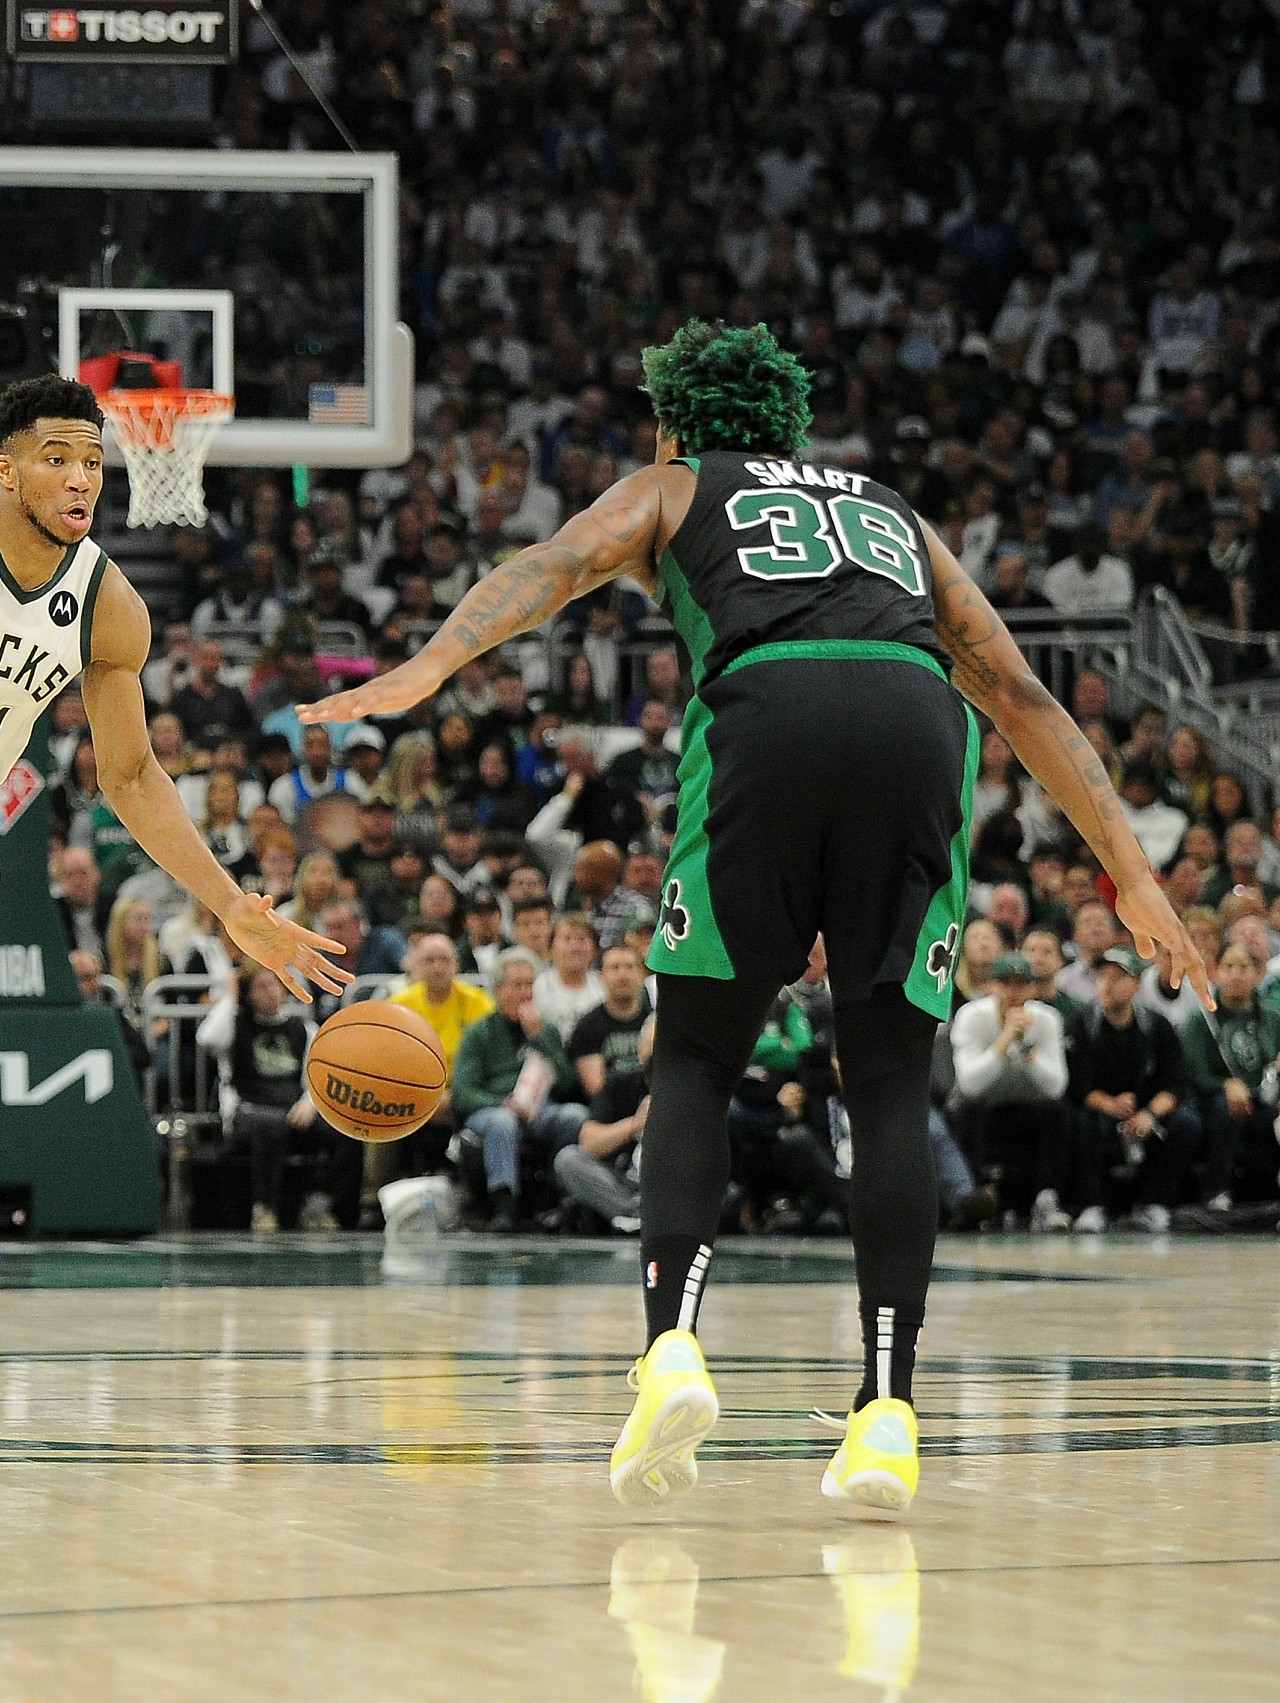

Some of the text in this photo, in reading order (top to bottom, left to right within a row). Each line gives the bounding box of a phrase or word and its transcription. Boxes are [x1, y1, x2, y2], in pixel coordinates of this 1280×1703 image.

[77, 10, 224, 43] TISSOT
[744, 461, 870, 495] SMART
[725, 488, 926, 596] 36
[326, 1073, 415, 1117] Wilson
